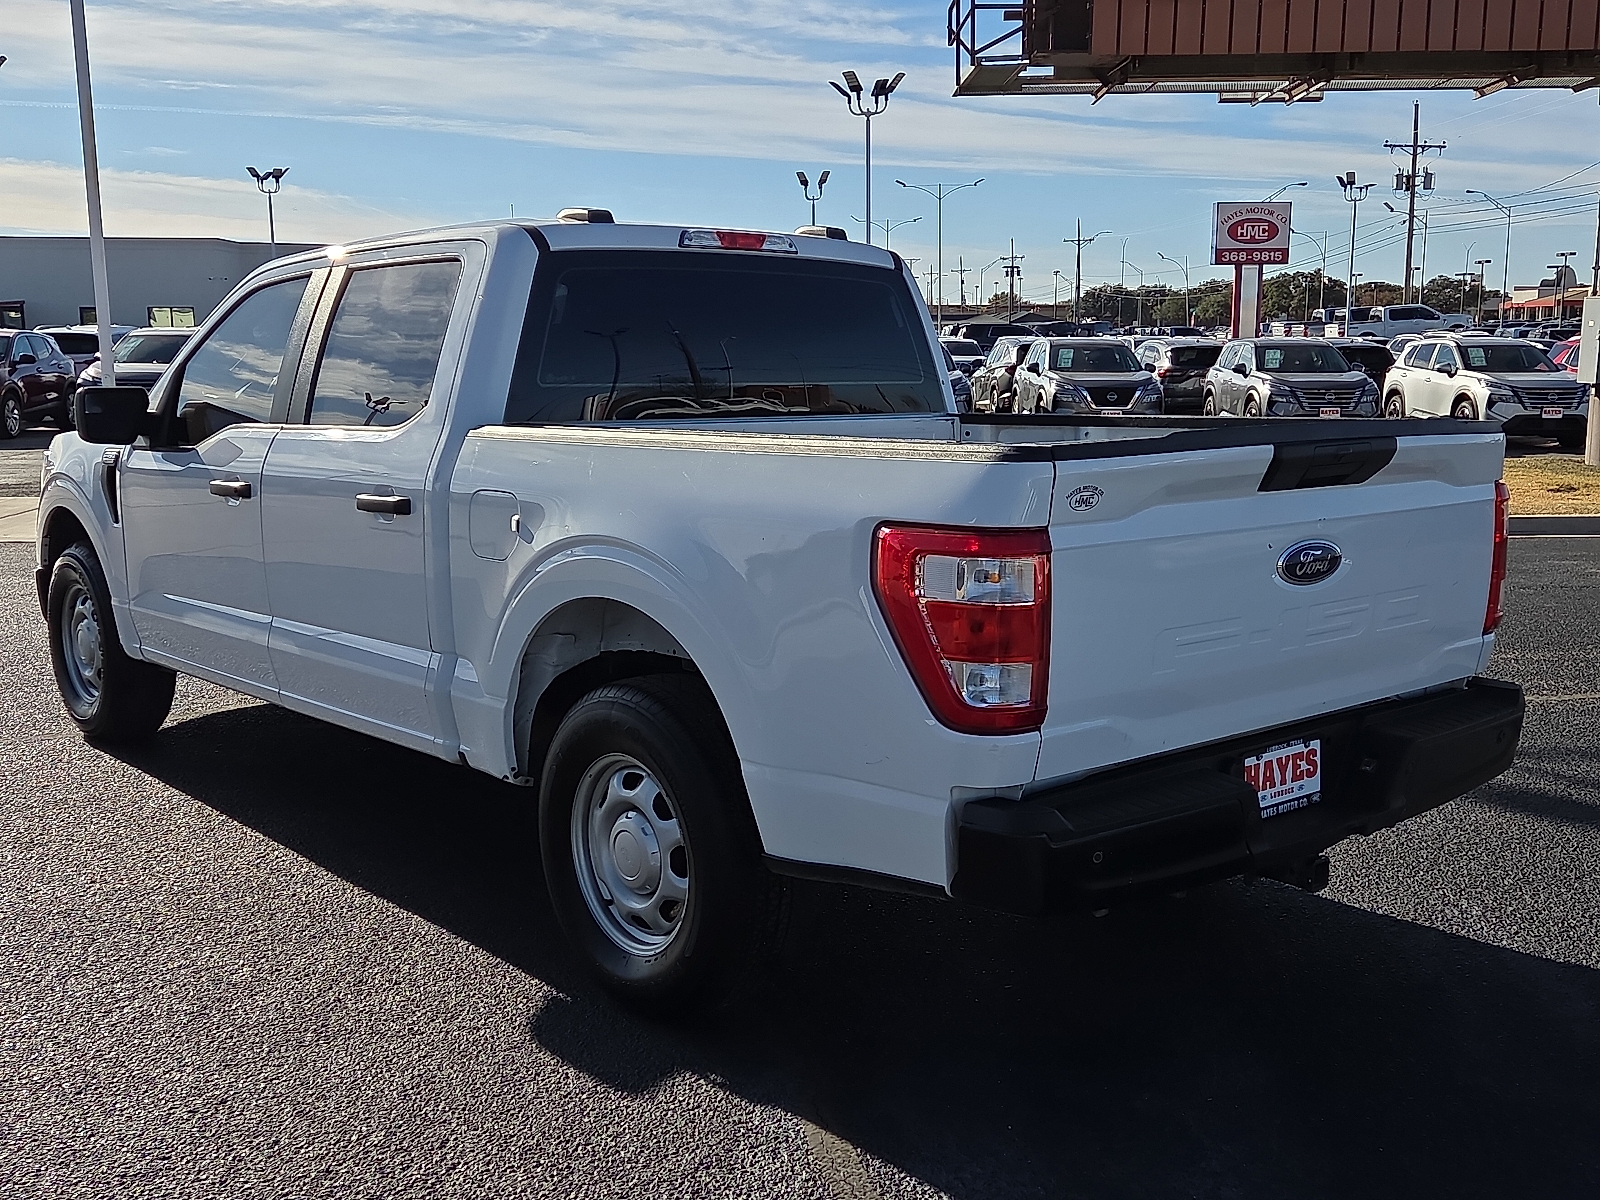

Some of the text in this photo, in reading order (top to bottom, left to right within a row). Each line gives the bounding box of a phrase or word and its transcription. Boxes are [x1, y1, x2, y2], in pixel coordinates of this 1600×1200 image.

[1220, 206, 1288, 226] HAYES MOTOR CO.
[1237, 222, 1269, 240] HMC
[1221, 251, 1283, 262] 368-9815
[1074, 493, 1095, 508] HMC
[1296, 549, 1331, 576] Ford
[1152, 585, 1431, 675] F-150
[1245, 748, 1318, 792] HAYES
[1279, 801, 1298, 813] MOTOR
